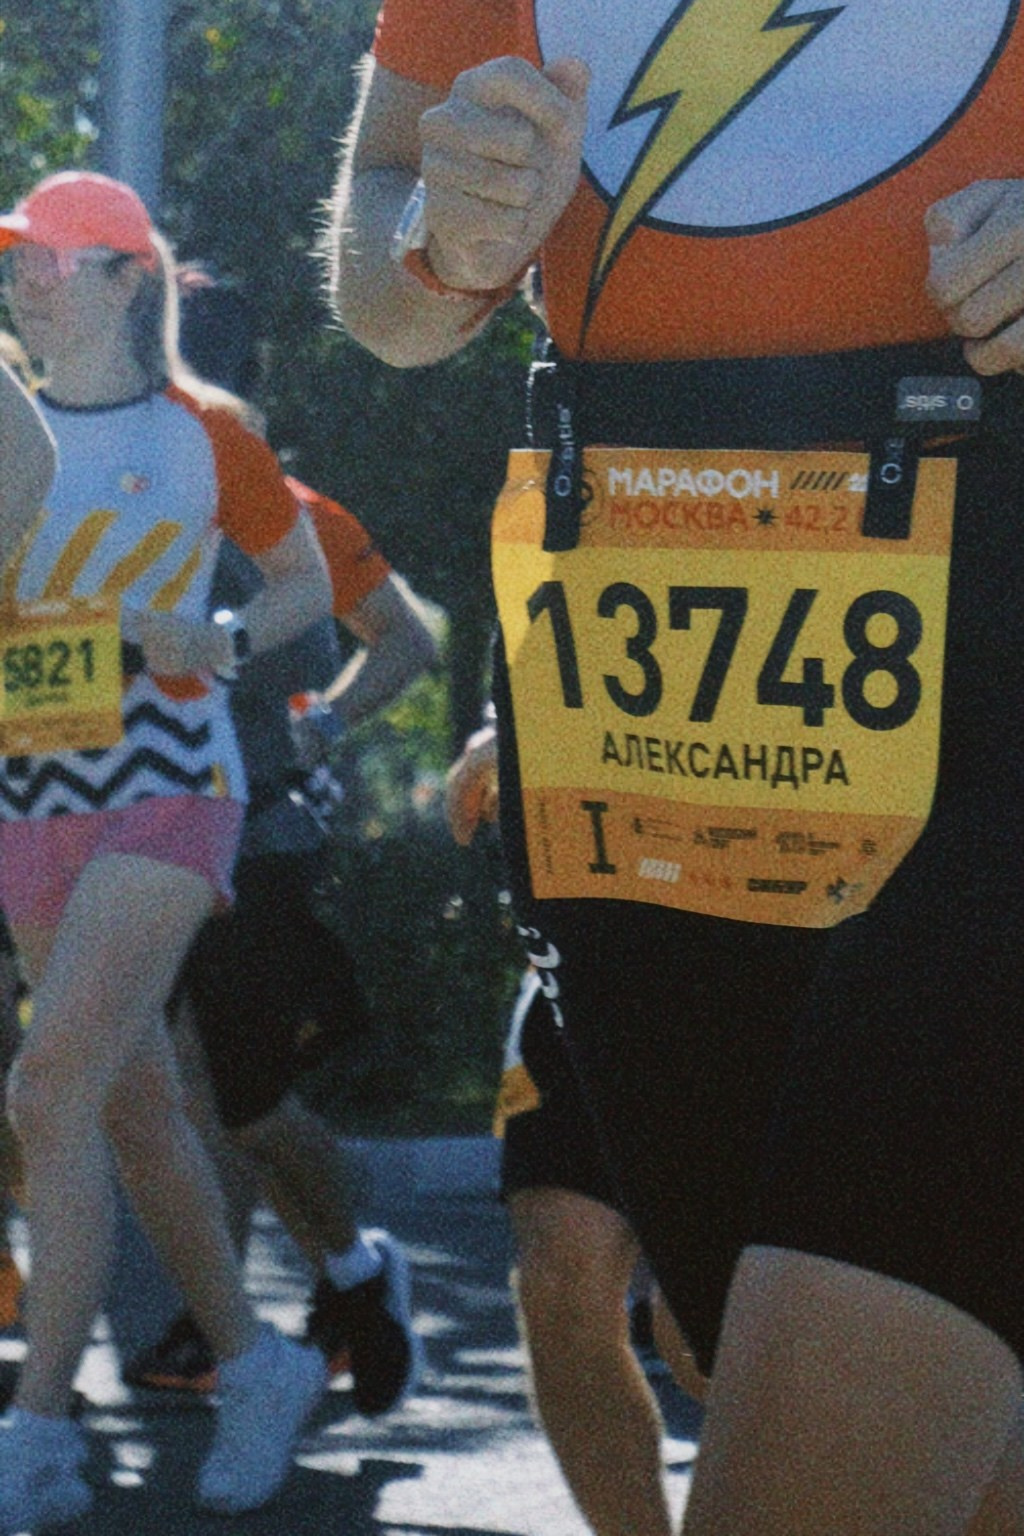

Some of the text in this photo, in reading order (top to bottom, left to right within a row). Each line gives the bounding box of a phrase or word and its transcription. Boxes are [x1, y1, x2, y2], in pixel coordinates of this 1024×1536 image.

[607, 466, 780, 498] МАРАФОН
[608, 499, 752, 532] МОСКВА
[525, 579, 924, 732] 13748
[600, 729, 851, 791] АЛЕКСАНДРА
